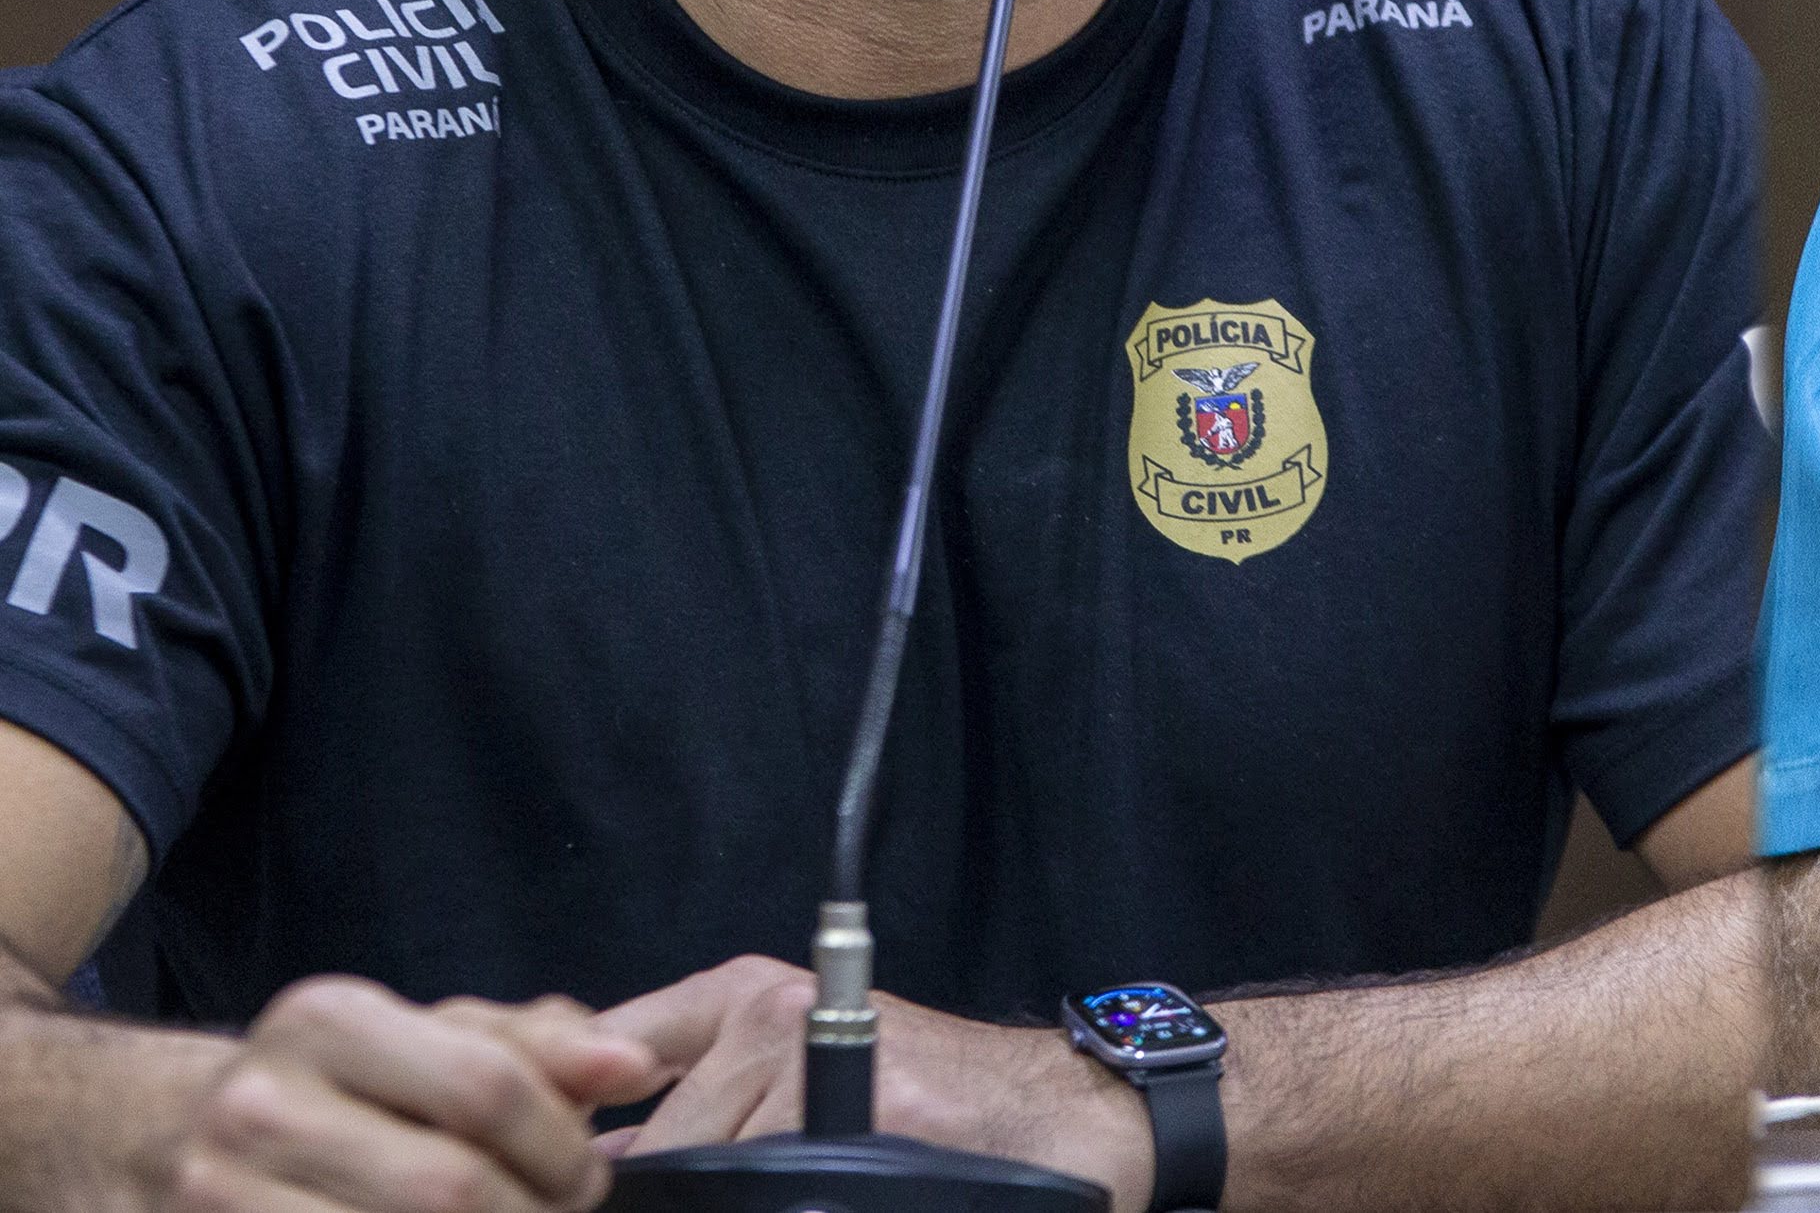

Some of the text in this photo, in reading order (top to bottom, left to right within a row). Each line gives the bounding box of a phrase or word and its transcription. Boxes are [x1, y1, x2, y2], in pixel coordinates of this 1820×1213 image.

[322, 40, 502, 99] CIVIL
[355, 97, 501, 145] PARAN
[1156, 315, 1273, 353] POLÍCIA
[1181, 484, 1281, 515] CIVIL
[1221, 528, 1252, 545] PR
